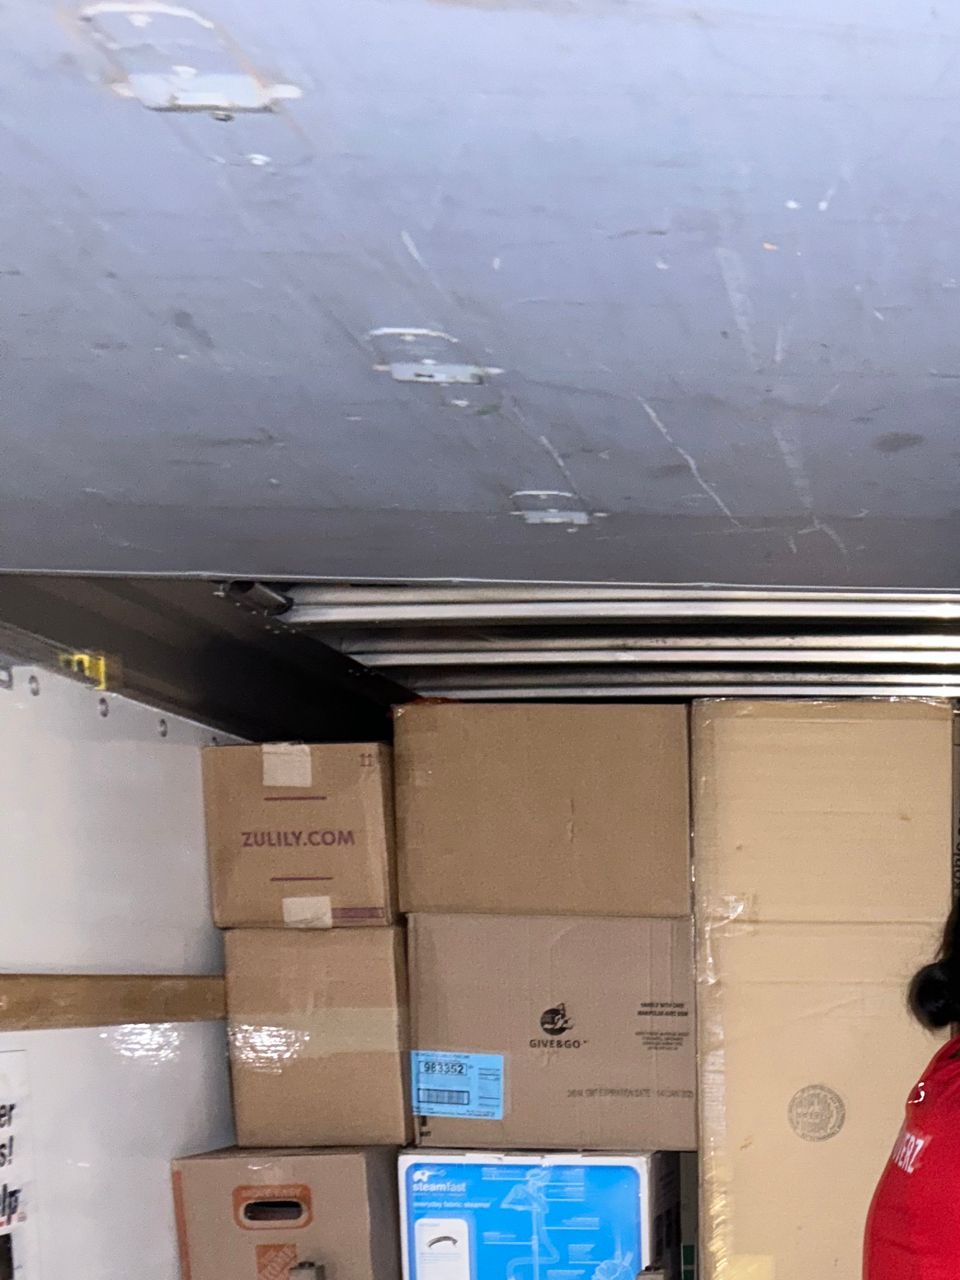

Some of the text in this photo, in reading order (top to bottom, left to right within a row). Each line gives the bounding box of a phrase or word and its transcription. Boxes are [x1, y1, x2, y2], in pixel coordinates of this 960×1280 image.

[241, 830, 356, 848] ZULILY.COM
[529, 1039, 581, 1049] GIVE&GO
[412, 1182, 466, 1193] steamfast
